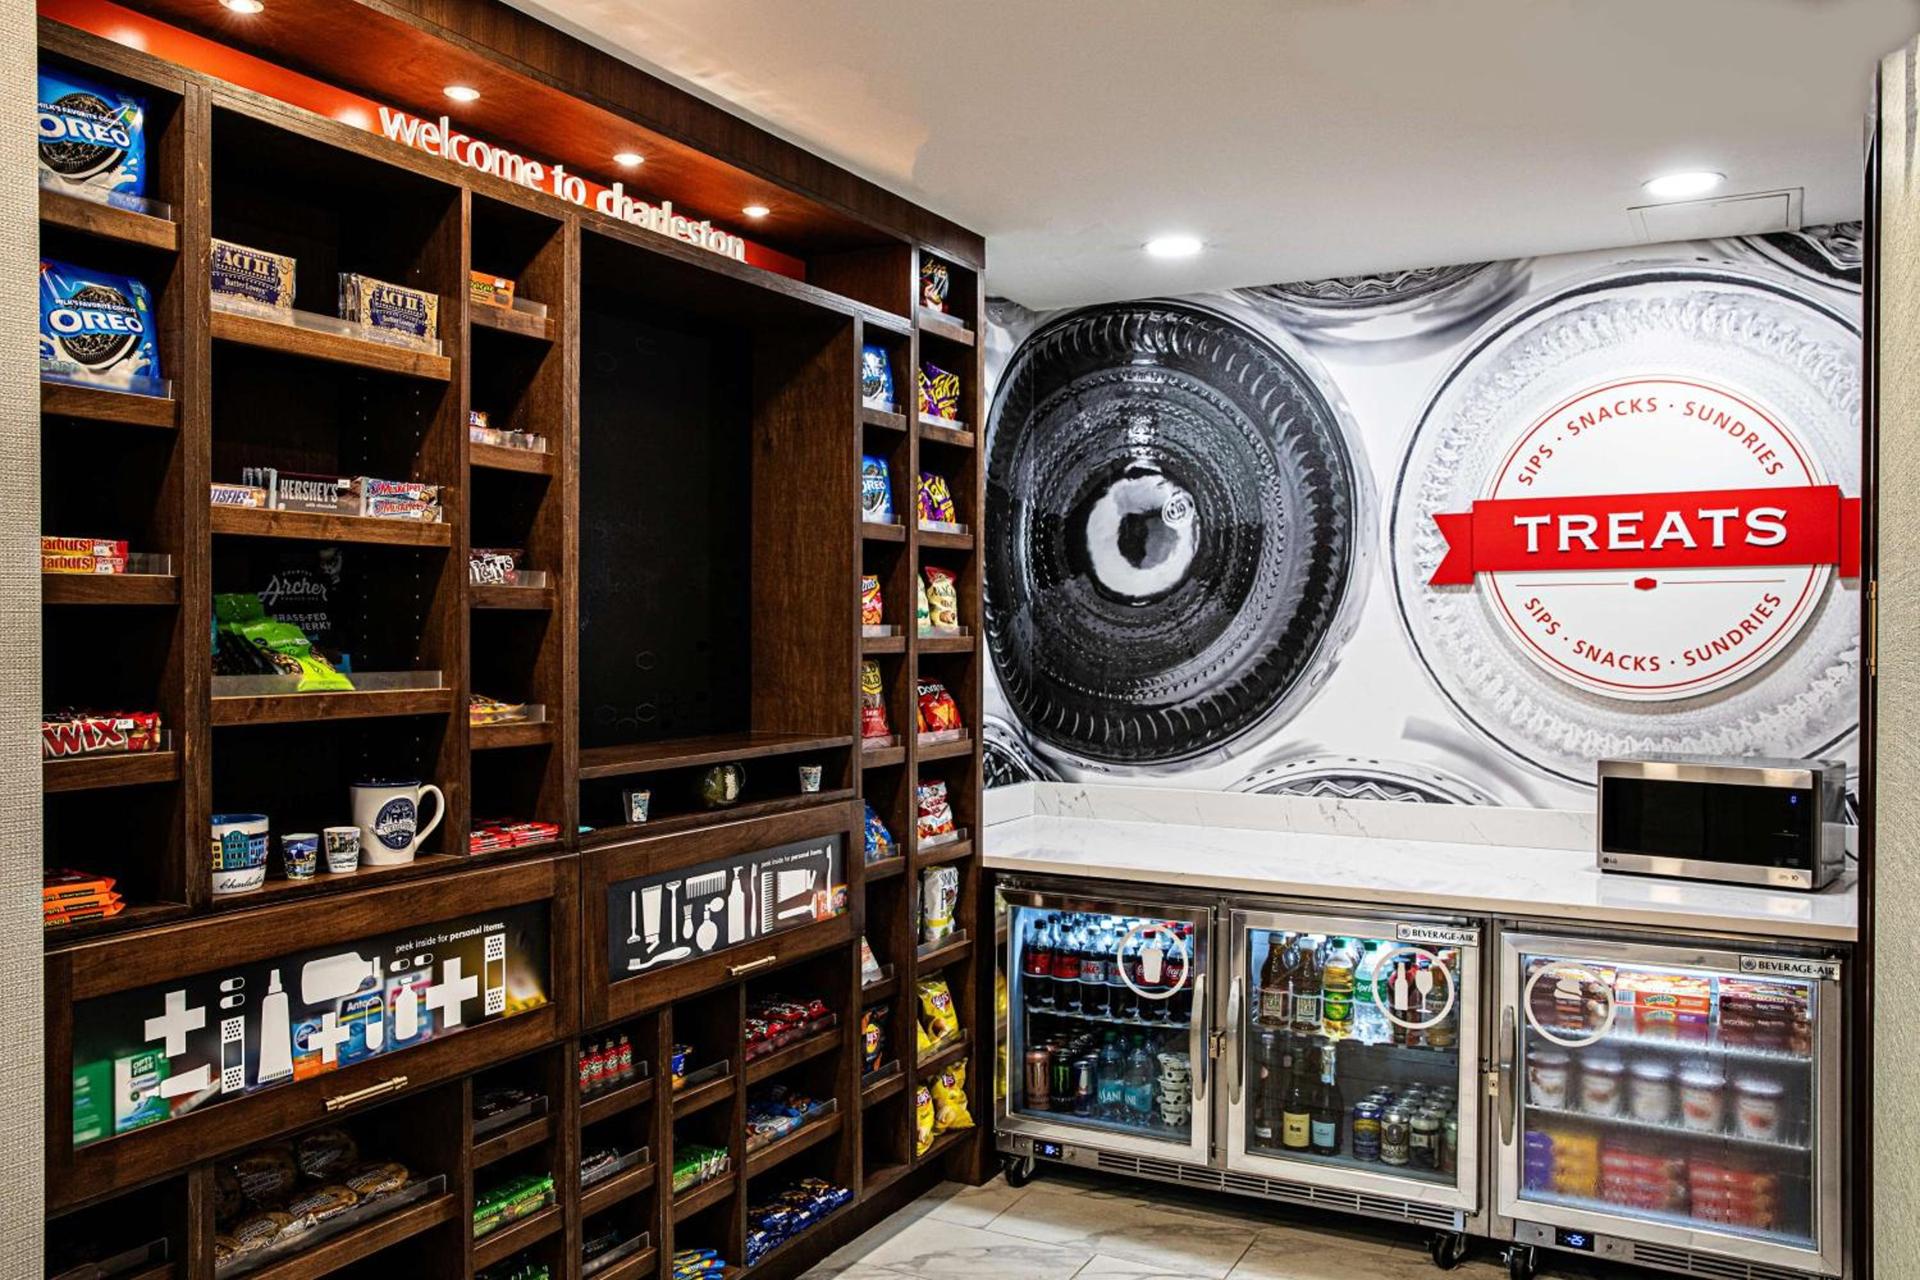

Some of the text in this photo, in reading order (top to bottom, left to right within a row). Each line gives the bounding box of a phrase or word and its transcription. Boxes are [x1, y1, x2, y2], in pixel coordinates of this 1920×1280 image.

[38, 112, 131, 148] OREO
[379, 107, 748, 264] welcome to charleston
[222, 250, 271, 275] ACT II
[380, 289, 419, 311] ACT II
[49, 308, 144, 334] OREO
[1518, 397, 1784, 486] SIPS SNACKS SUNDRIES
[280, 479, 339, 503] HERSHEY'S
[1513, 507, 1787, 554] TREATS
[257, 574, 328, 606] Archer
[1524, 592, 1783, 672] SIPS SNACKS SUNDRIES
[42, 718, 124, 757] WIX
[395, 922, 506, 954] peek inside for personal items.
[1412, 928, 1474, 942] BEVERAGE-AIR
[1758, 960, 1835, 976] BEVERAGE-AIR
[1356, 982, 1374, 994] Spri
